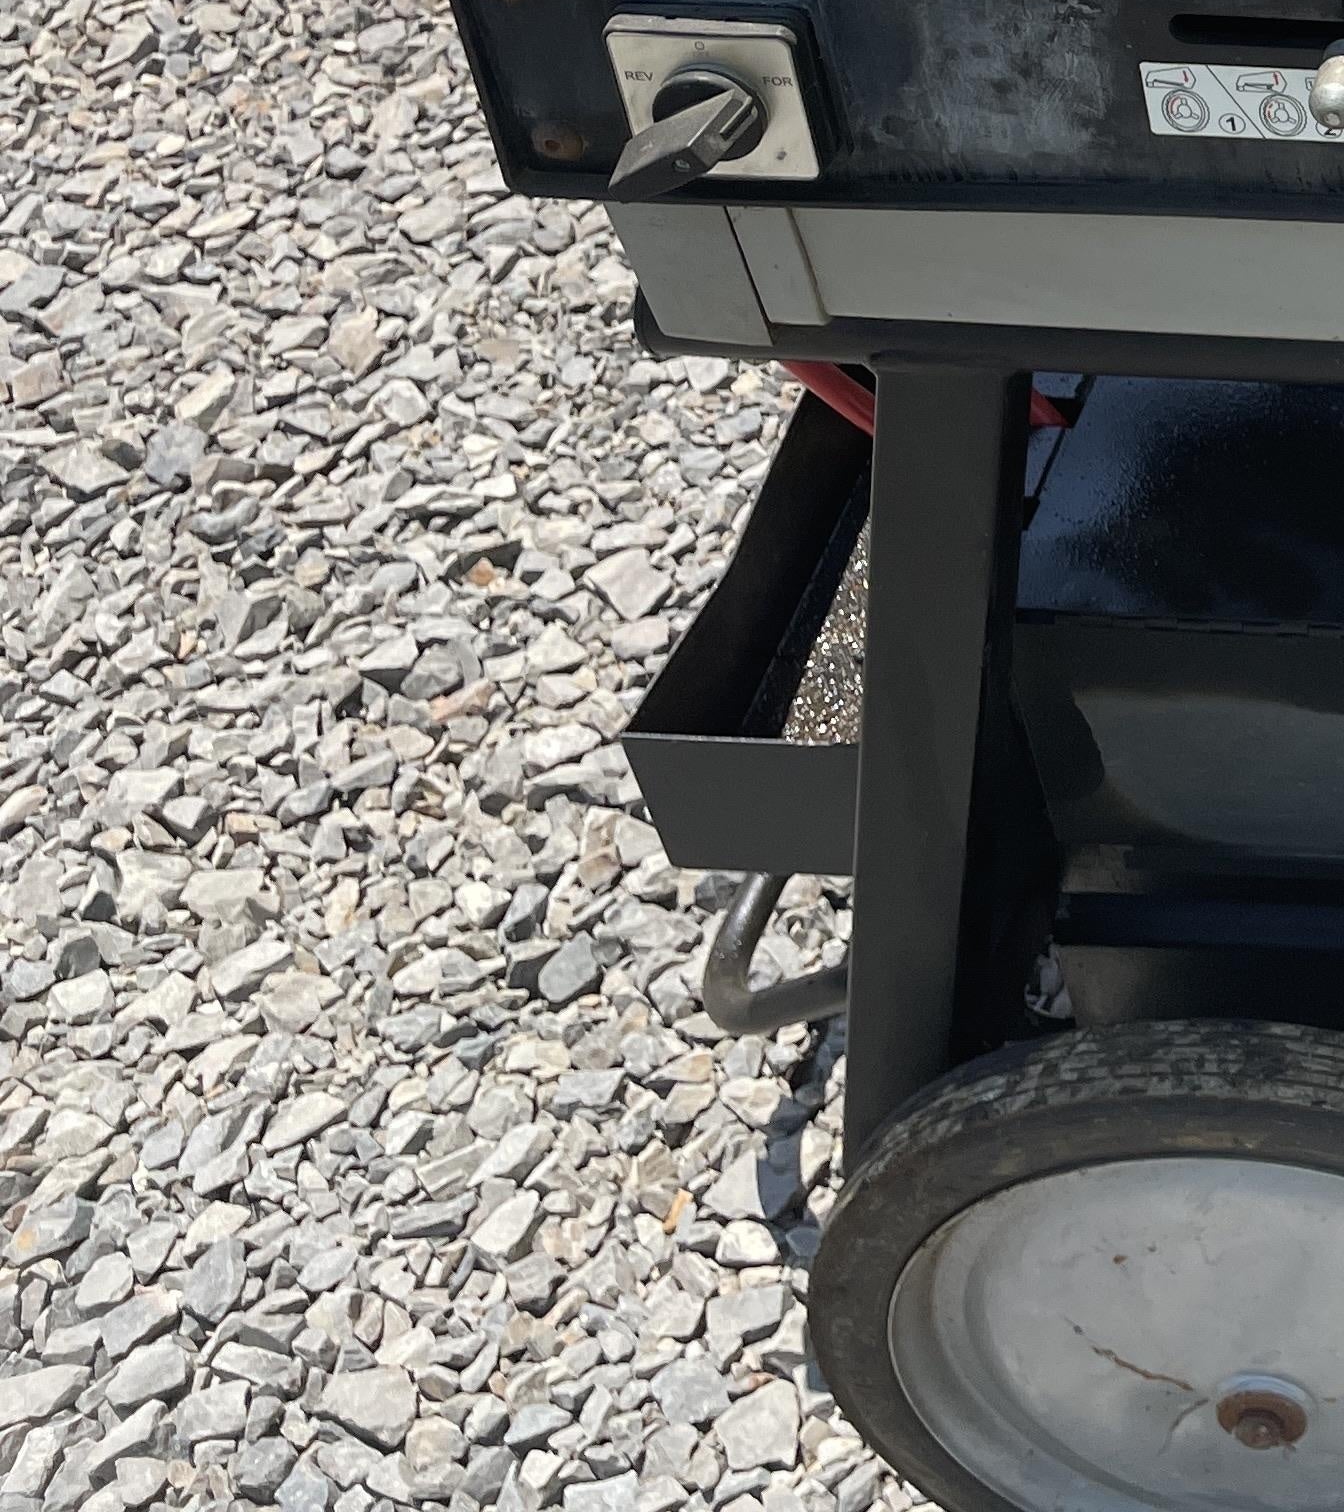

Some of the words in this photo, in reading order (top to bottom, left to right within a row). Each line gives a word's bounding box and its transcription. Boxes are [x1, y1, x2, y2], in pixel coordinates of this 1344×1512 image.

[624, 70, 654, 82] REV
[762, 75, 793, 87] FOR
[1226, 117, 1237, 131] 1
